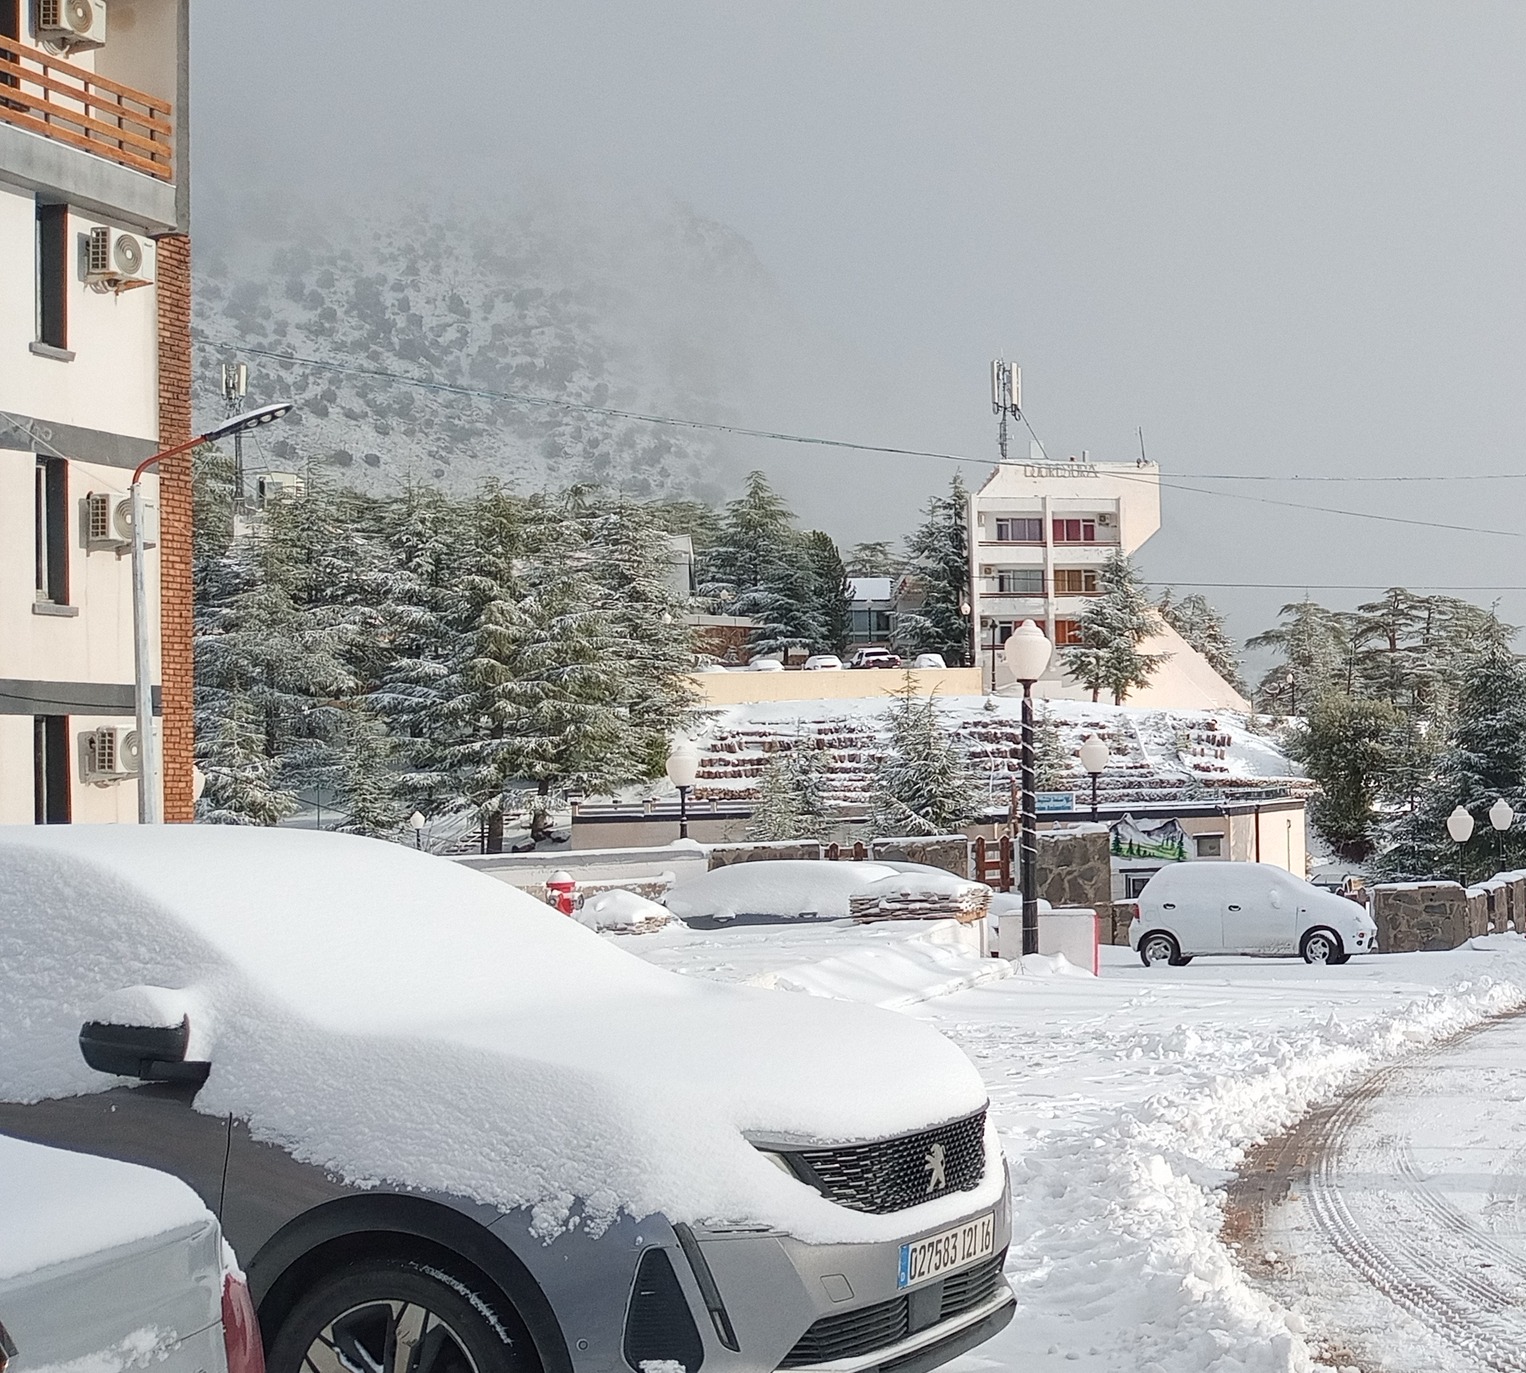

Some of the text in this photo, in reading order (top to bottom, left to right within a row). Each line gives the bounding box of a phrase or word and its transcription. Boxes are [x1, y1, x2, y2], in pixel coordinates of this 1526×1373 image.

[909, 1219, 991, 1280] 027583 121 16
